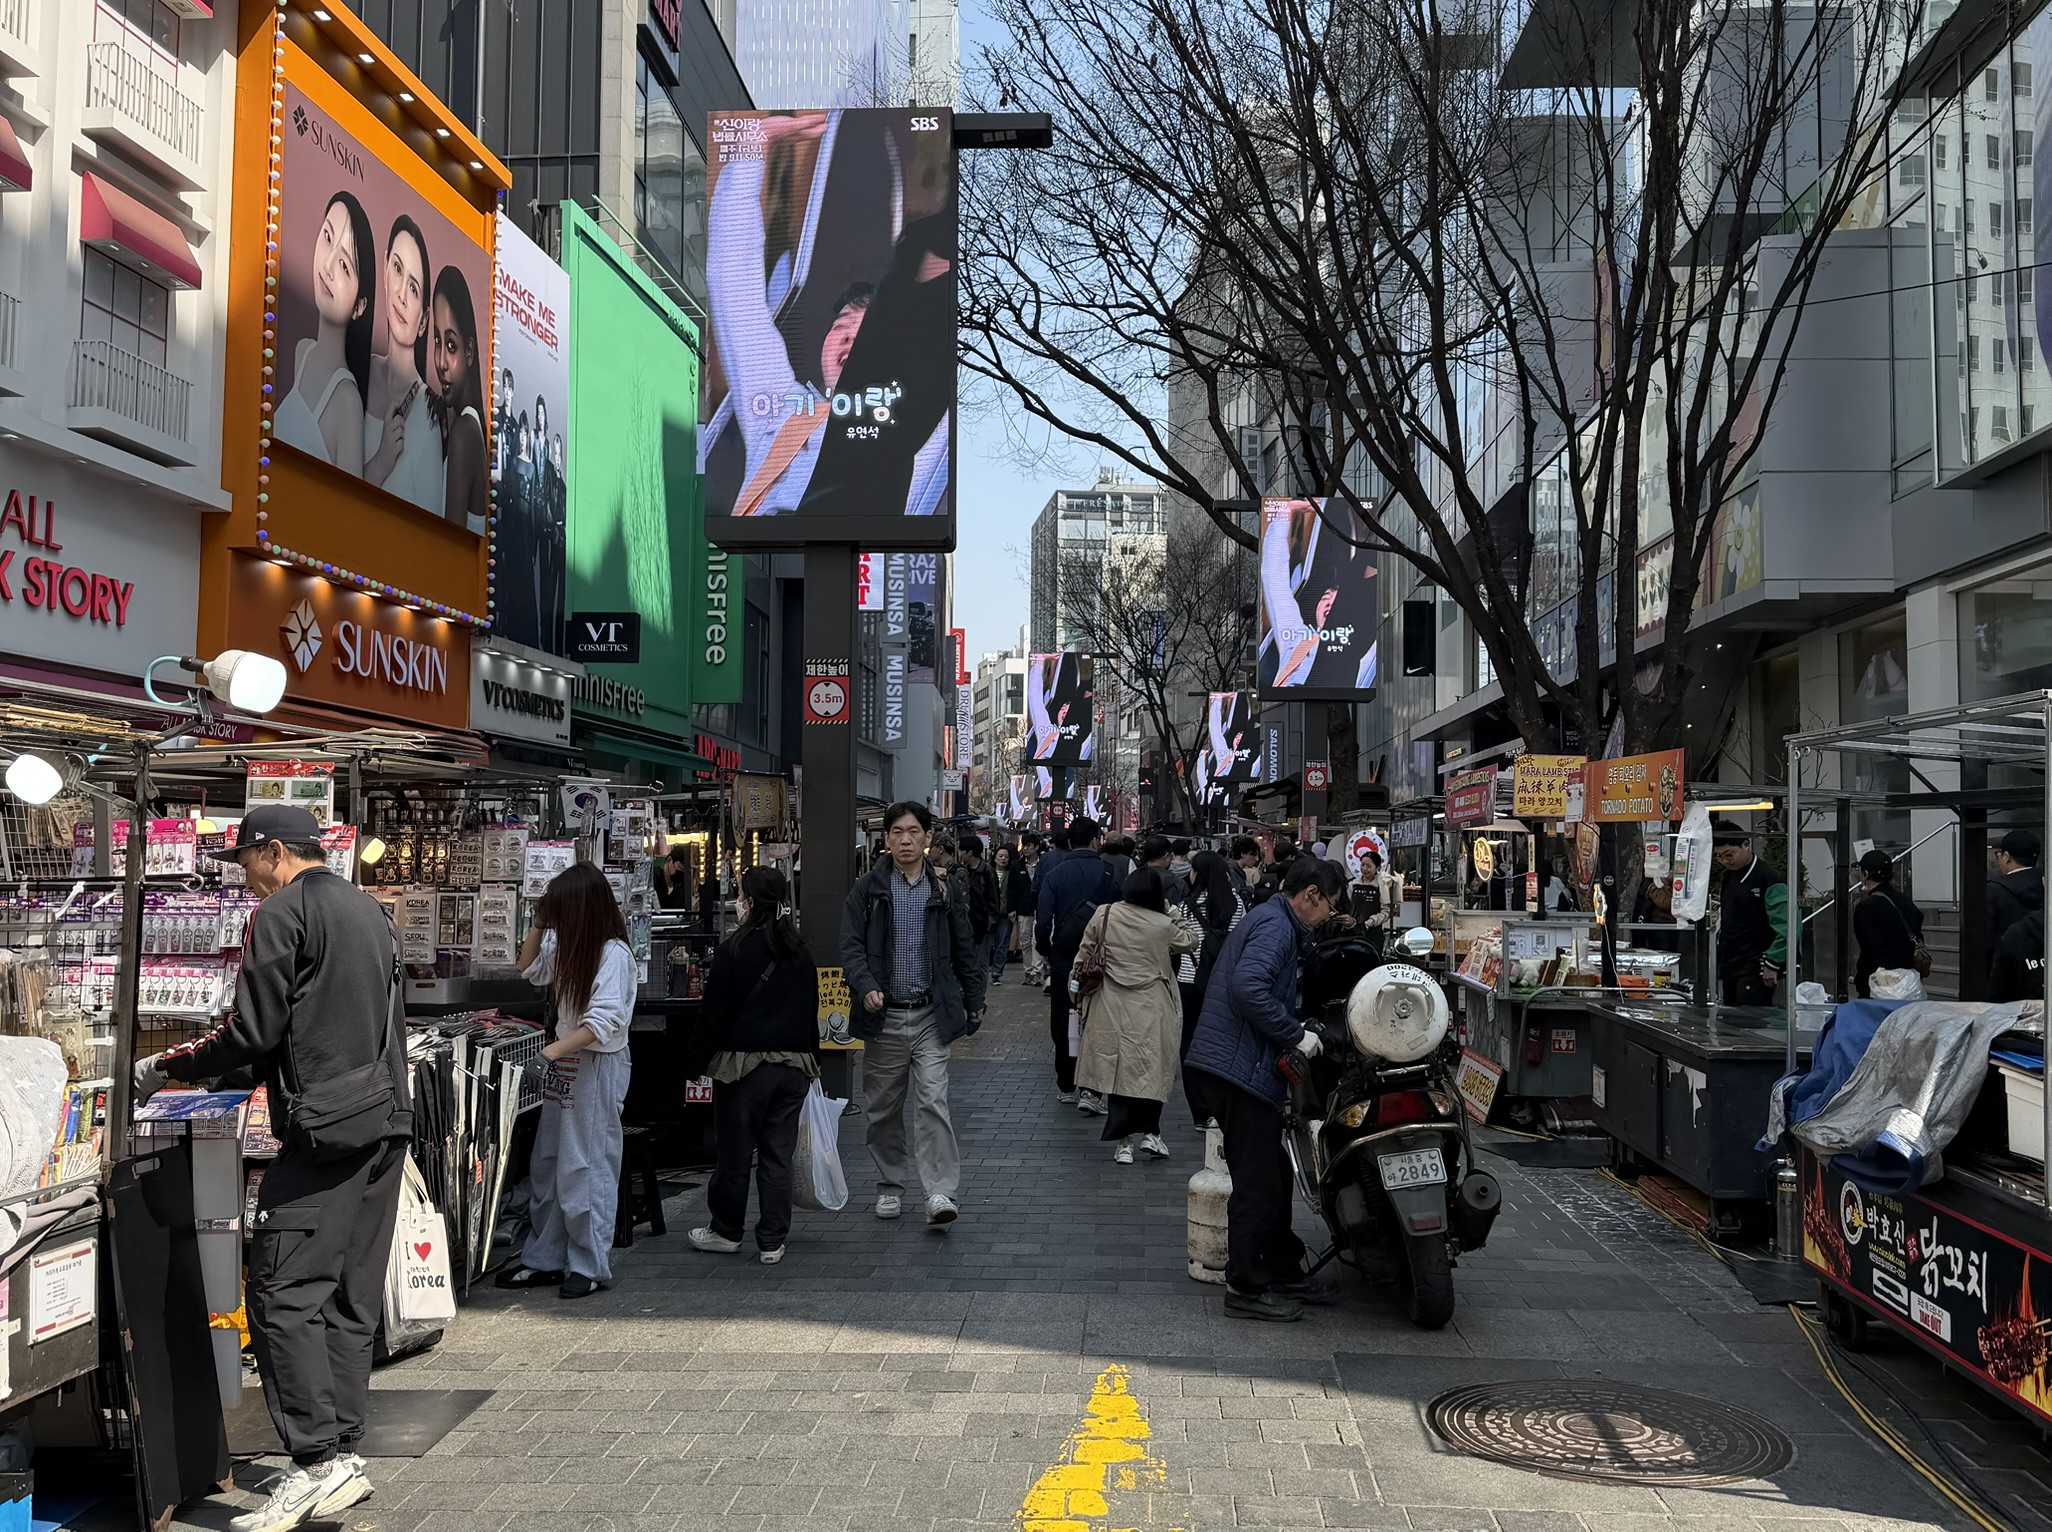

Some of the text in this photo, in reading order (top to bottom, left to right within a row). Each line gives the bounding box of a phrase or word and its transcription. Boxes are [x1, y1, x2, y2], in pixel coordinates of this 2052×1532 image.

[910, 117, 939, 131] SBS
[311, 120, 365, 184] SUNSKIN
[499, 267, 556, 329] MAKE ME
[495, 290, 558, 353] STRONGER
[846, 426, 880, 439] 유연석
[0, 489, 63, 551] ALL
[22, 556, 134, 626] STORY
[887, 553, 904, 636] MUSINSA
[585, 622, 624, 642] VT
[333, 620, 447, 695] SUNSKIN
[578, 643, 628, 652] COSMETICS
[805, 663, 848, 676] 제한높이
[814, 693, 843, 704] 3.5m
[885, 655, 903, 741] MUSINSA
[209, 721, 237, 739] STORY
[1269, 728, 1278, 783] SALOMON
[1542, 767, 1562, 777] LAMB
[1519, 796, 1563, 808] 마라 양꼬치
[1601, 797, 1654, 815] TORNADO POTATO
[1398, 1162, 1440, 1182] 2849
[1866, 1205, 1906, 1256] 박효신
[1919, 1215, 1987, 1314] 닭꼬치
